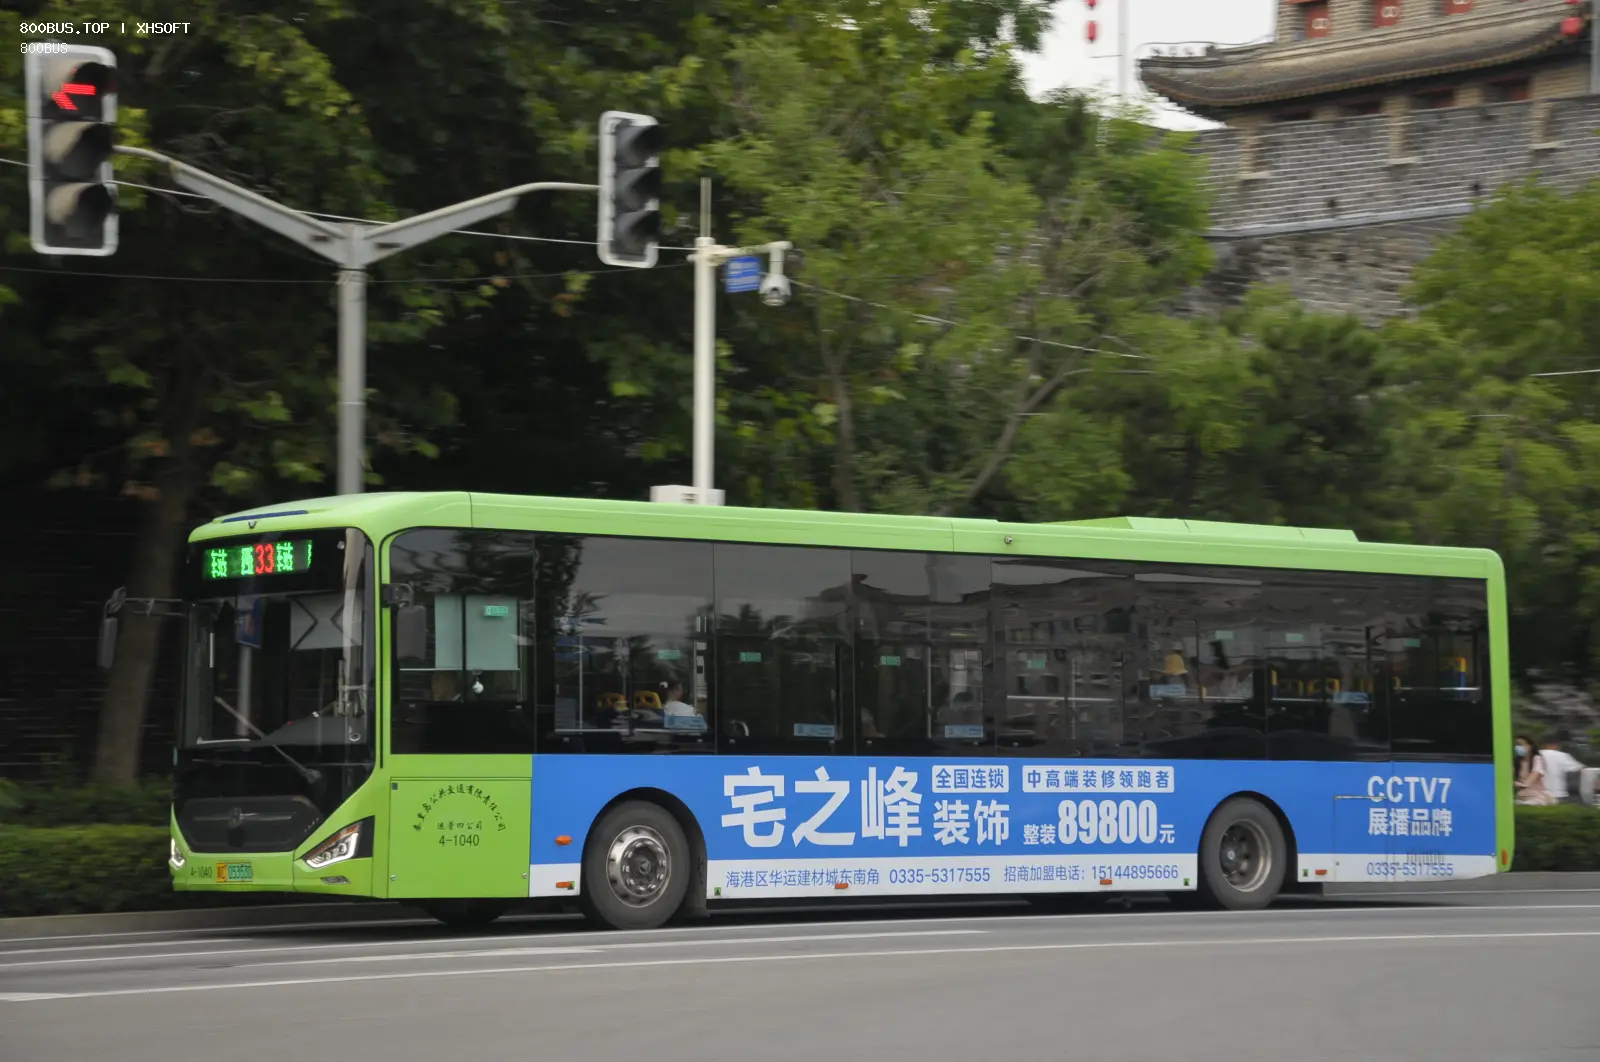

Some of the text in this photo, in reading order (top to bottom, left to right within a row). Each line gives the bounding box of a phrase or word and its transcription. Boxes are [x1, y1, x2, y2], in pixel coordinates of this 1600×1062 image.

[255, 544, 275, 574] 33
[935, 768, 1004, 789] 全国连锁
[1027, 769, 1170, 789] 中高端装修领跑者
[1367, 775, 1452, 803] CCTV7
[721, 765, 923, 848] 宅之峰
[933, 800, 1010, 846] 装饰
[1368, 807, 1453, 836] 展播品牌
[438, 834, 480, 847] 4-1040
[726, 868, 880, 888] 海港区华运建材城东南角
[889, 867, 991, 885] 0335-5317555
[1366, 862, 1454, 876] 0335-5317555
